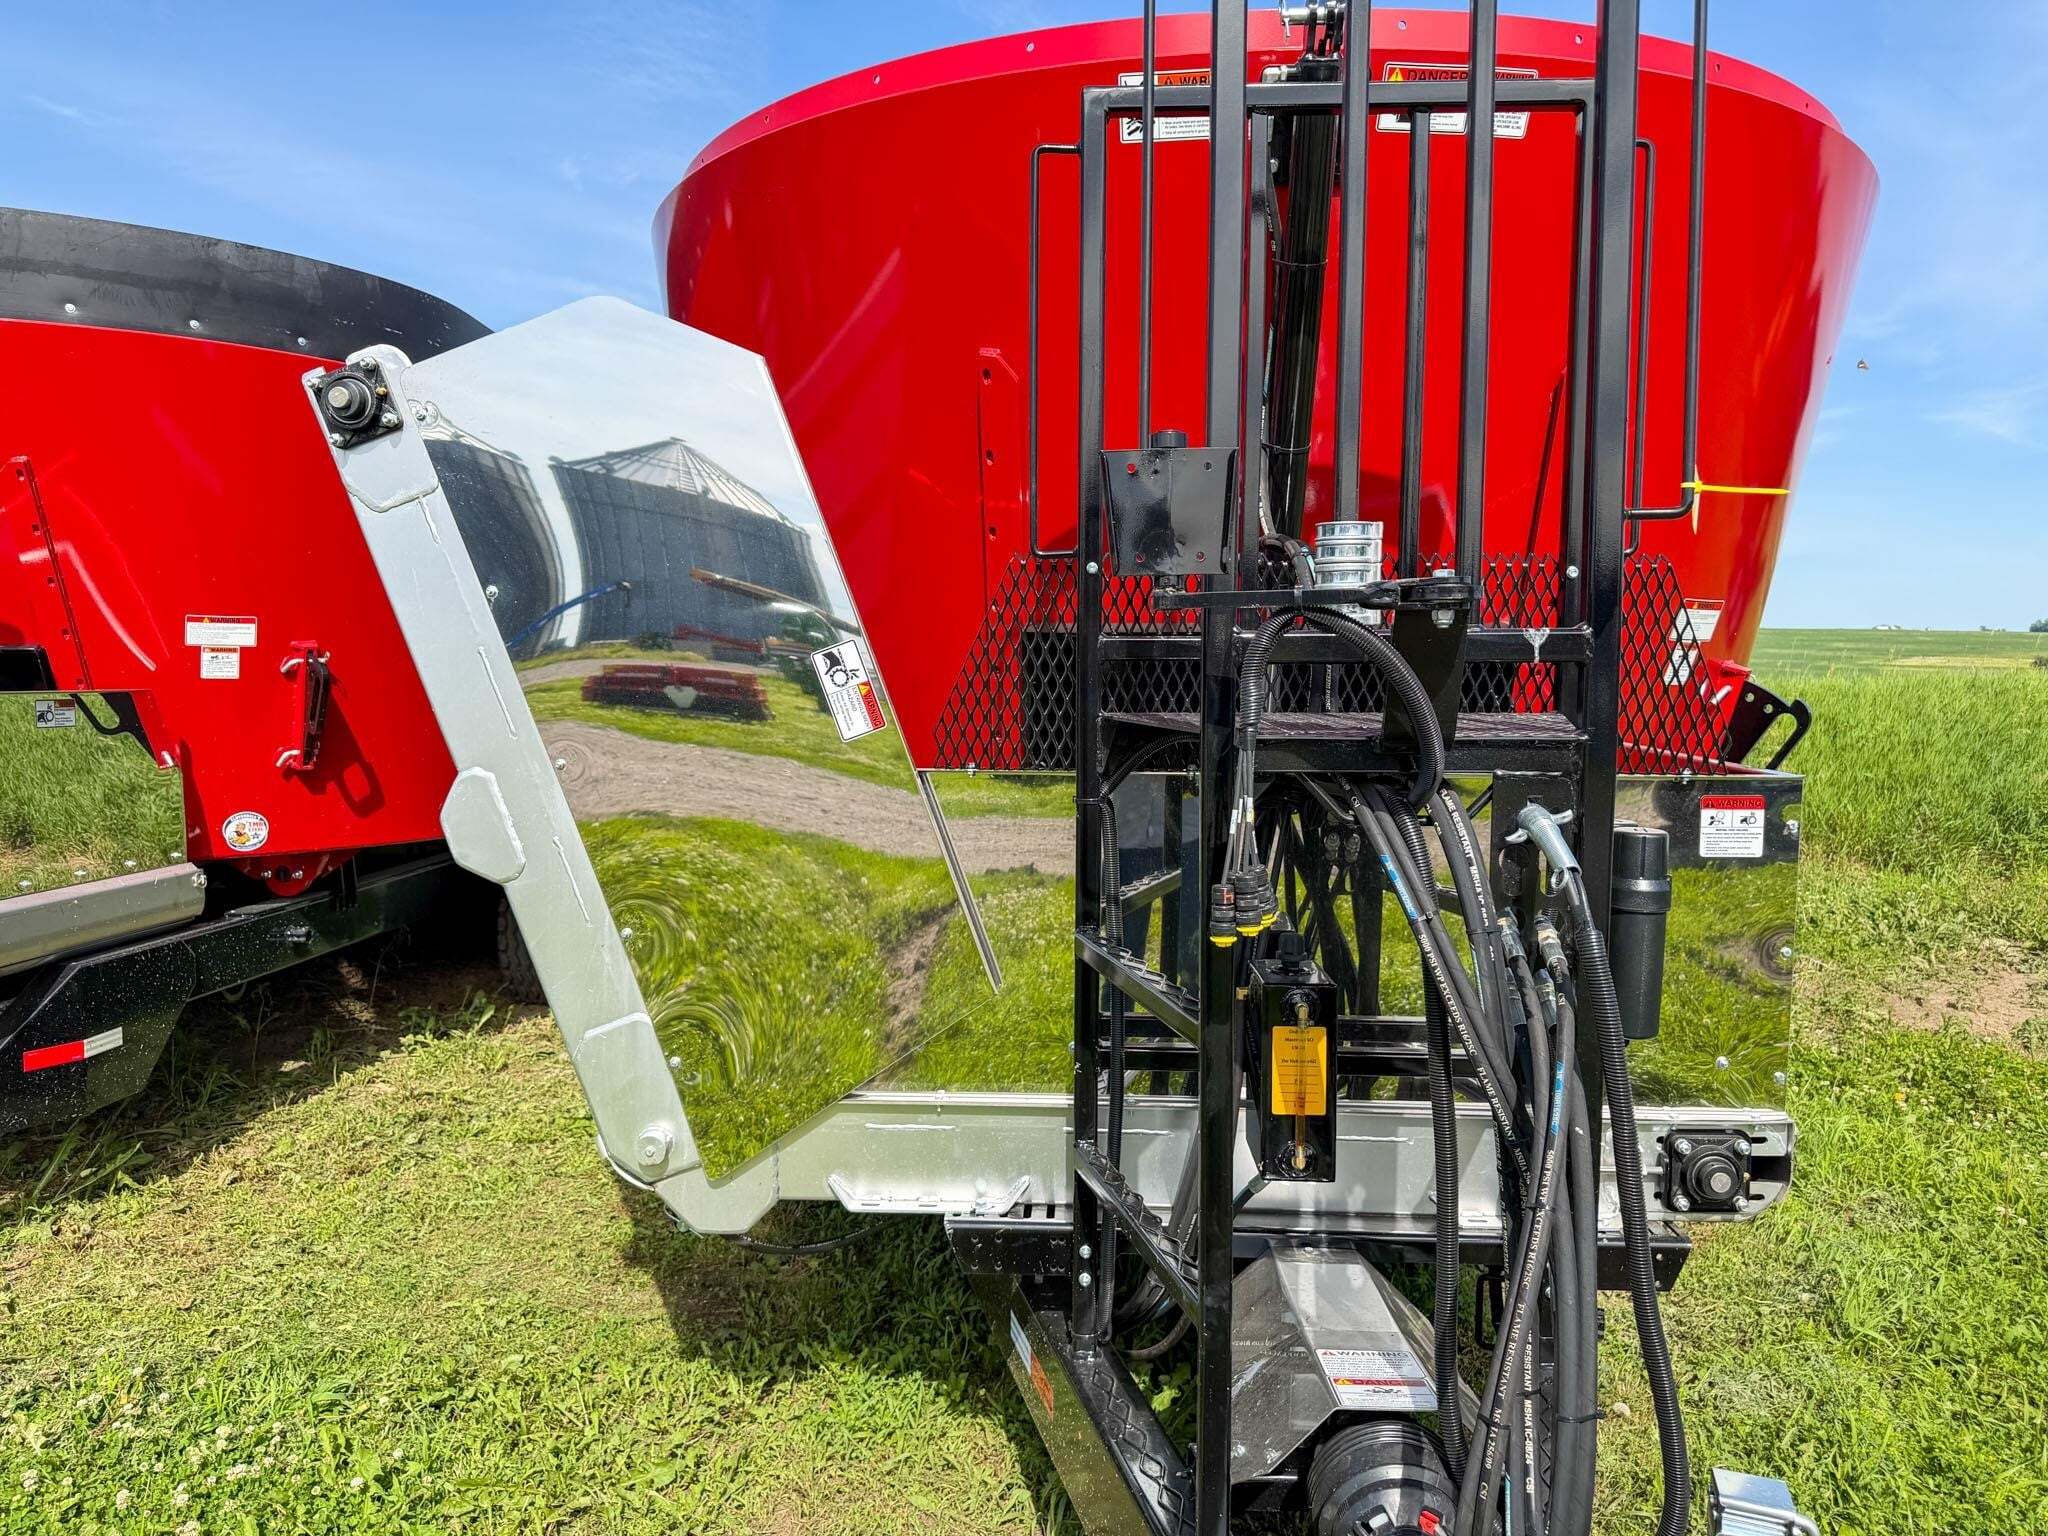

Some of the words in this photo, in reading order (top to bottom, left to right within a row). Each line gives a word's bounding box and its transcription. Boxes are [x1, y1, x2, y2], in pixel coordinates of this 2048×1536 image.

[865, 692, 882, 727] WARNING
[1351, 796, 1360, 808] CSI
[1717, 799, 1761, 807] WARNING
[1452, 811, 1473, 858] RESISTANT
[1419, 934, 1432, 951] 5000
[1427, 950, 1438, 967] PSI
[1434, 967, 1444, 983] WP
[1440, 983, 1462, 1023] EXCEEDS
[1477, 1067, 1495, 1098] FLAME
[1492, 1097, 1515, 1141] RESISTANT
[1514, 1148, 1527, 1172] MSHA
[1541, 1168, 1553, 1184] PSI
[1511, 1303, 1526, 1339] FLAME
[1498, 1341, 1517, 1399] RESISTANT
[1524, 1344, 1532, 1391] RESISTANT
[1524, 1399, 1532, 1428] MSHA
[1480, 1482, 1488, 1500] CSI
[1526, 1477, 1534, 1494] CSI
